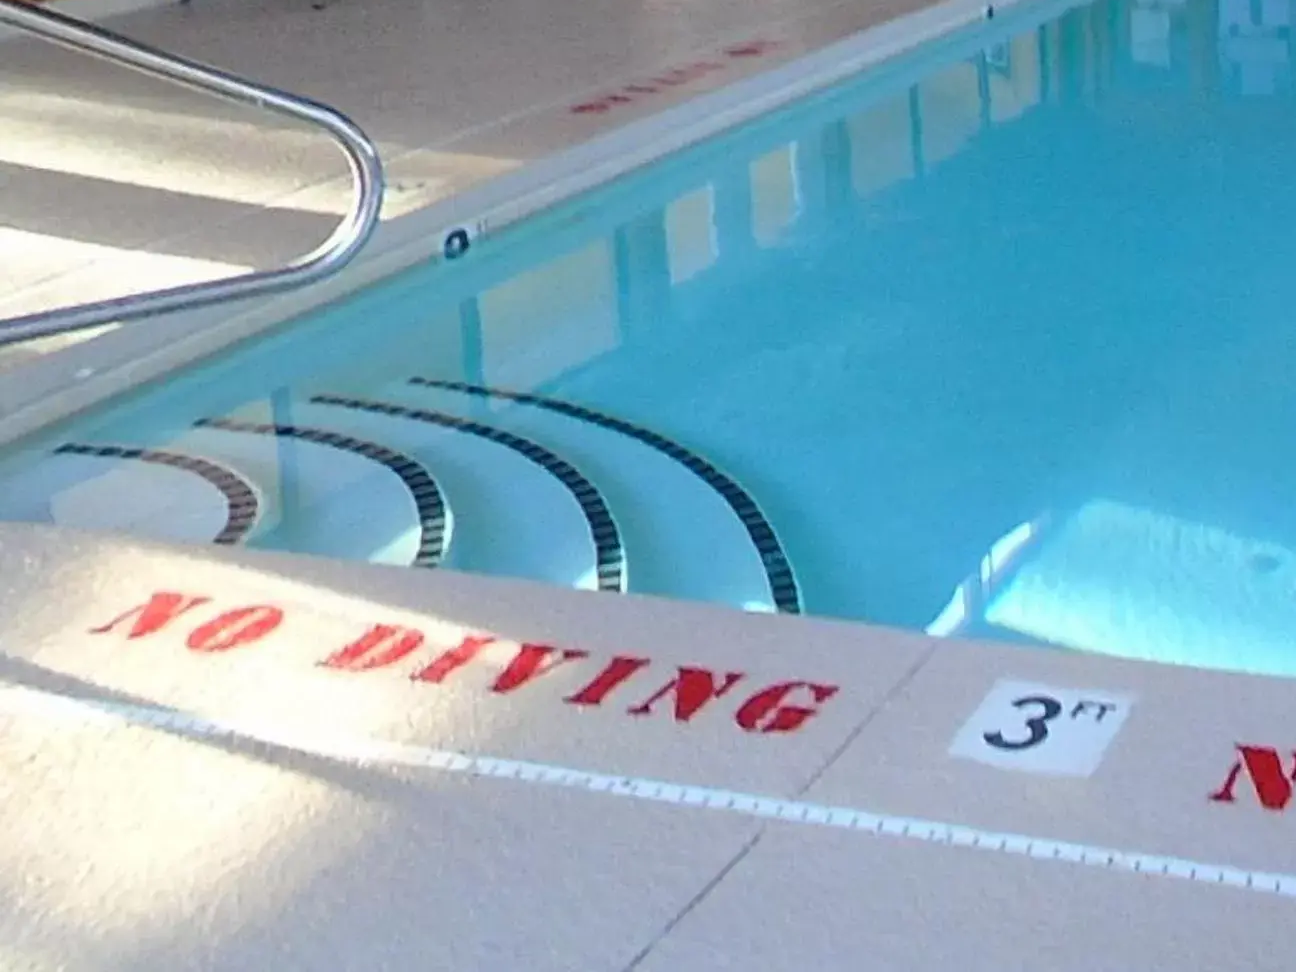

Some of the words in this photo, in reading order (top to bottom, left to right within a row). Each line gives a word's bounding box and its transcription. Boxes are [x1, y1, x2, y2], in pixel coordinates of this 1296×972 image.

[90, 590, 285, 652] NO
[314, 622, 840, 734] DIVING
[983, 696, 1062, 751] 3
